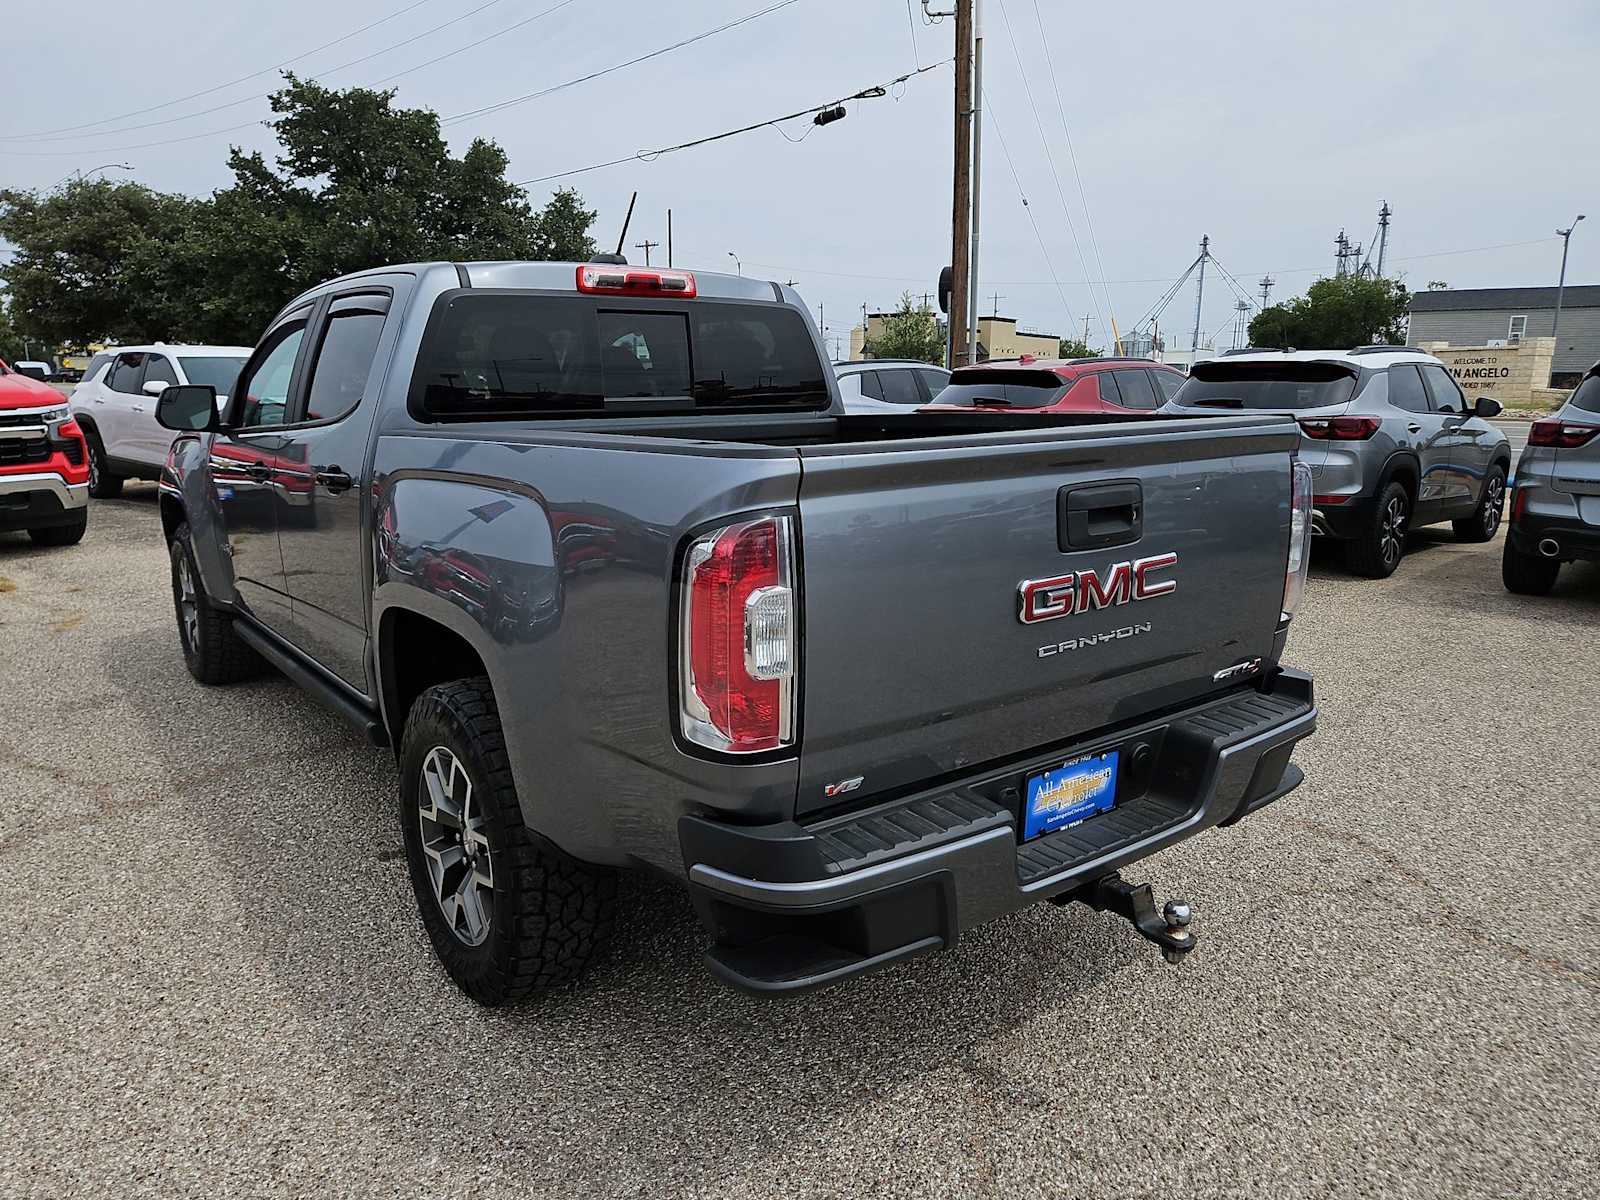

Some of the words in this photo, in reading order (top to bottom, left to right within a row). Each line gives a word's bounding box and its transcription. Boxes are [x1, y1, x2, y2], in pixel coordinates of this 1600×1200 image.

[1463, 367, 1509, 378] ANGELO
[1017, 551, 1178, 625] GMC
[1037, 621, 1152, 658] CANYON
[824, 776, 865, 797] V6
[1034, 780, 1054, 801] All
[1058, 767, 1112, 791] American
